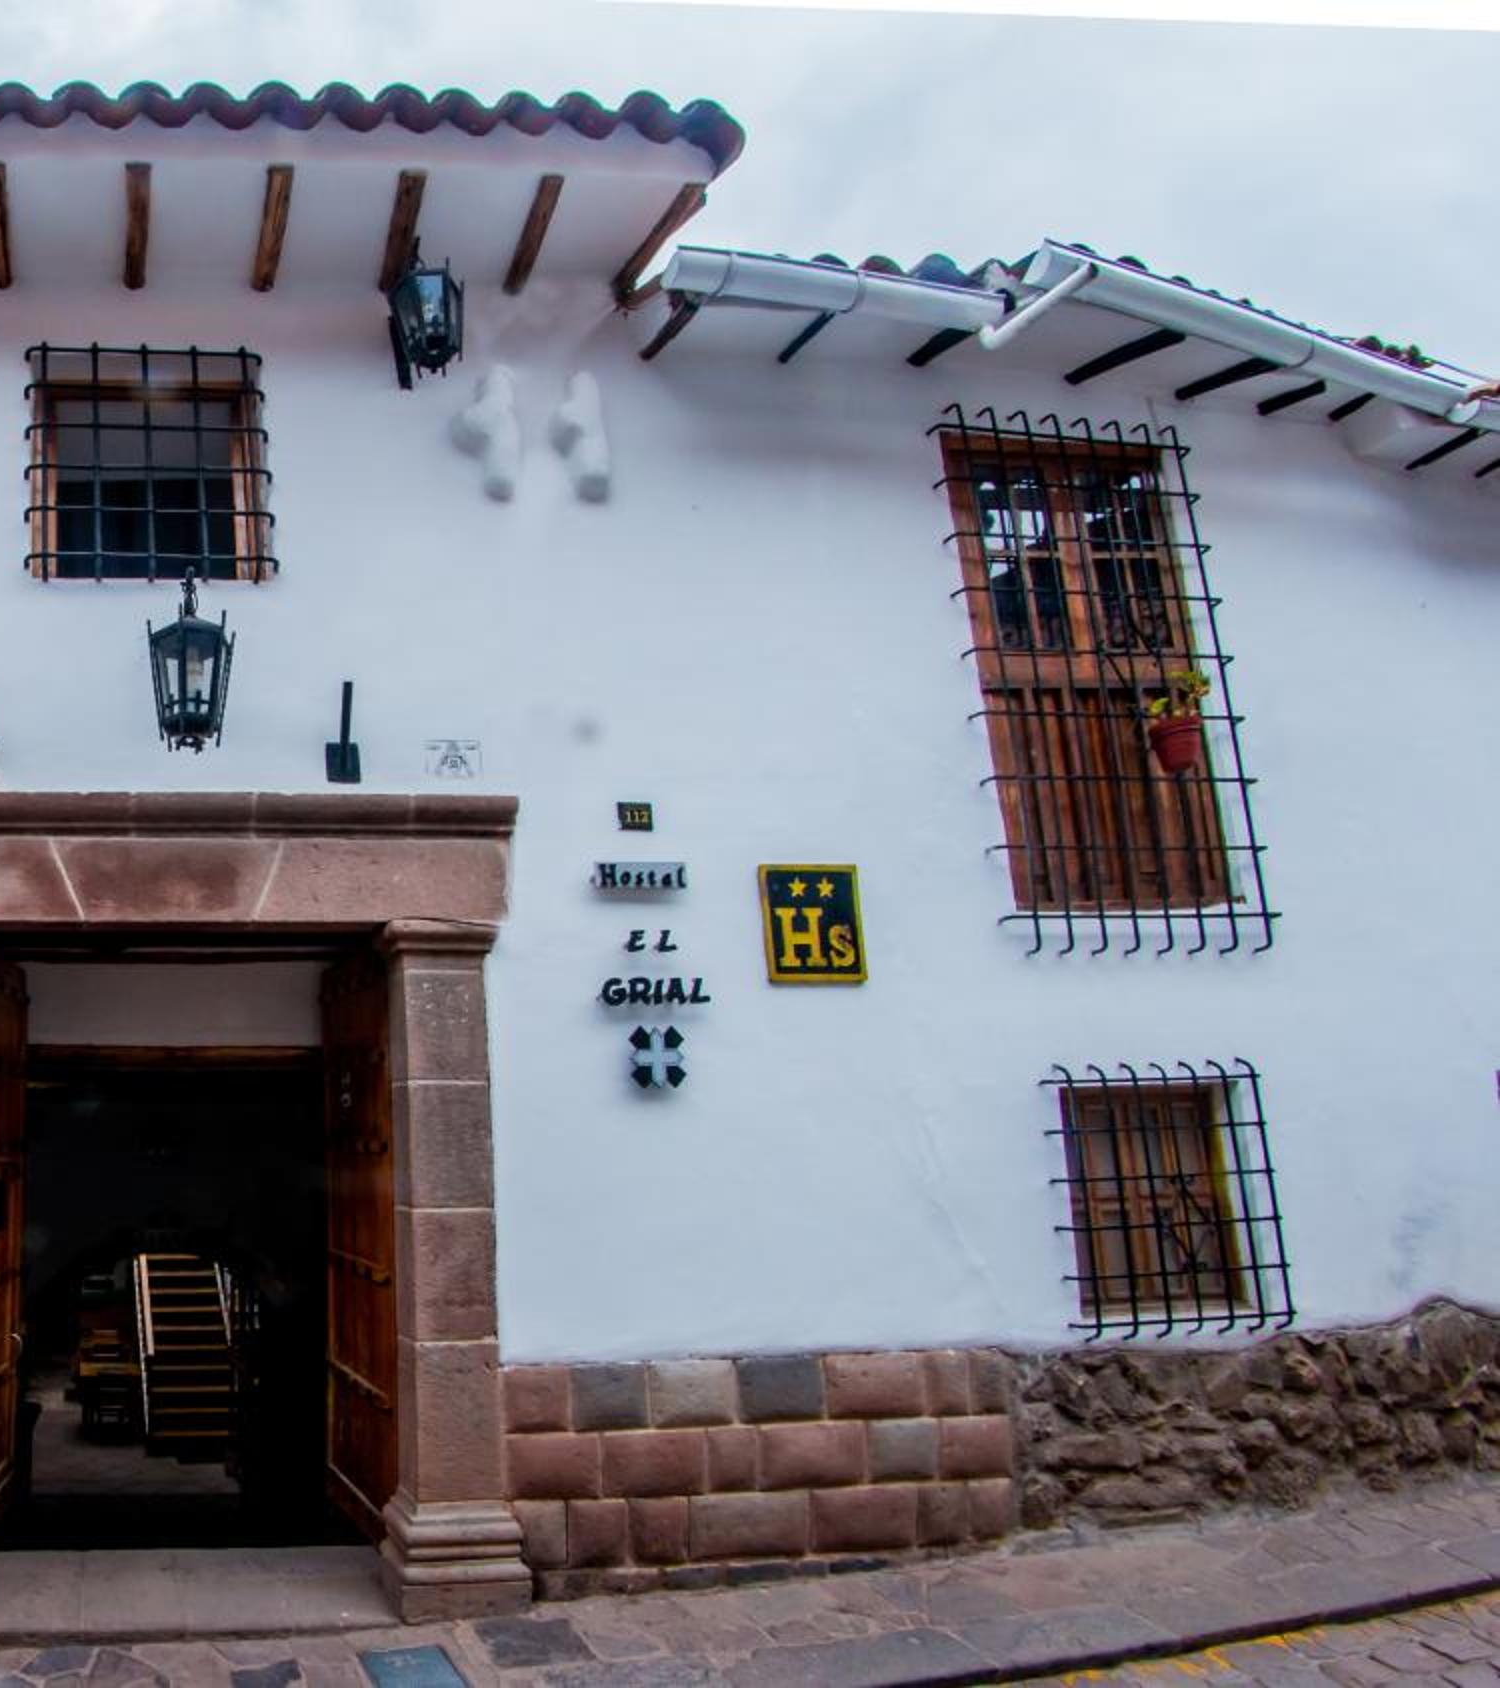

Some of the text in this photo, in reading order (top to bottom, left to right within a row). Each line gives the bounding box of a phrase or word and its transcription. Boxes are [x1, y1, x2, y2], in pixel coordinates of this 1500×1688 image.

[599, 863, 687, 888] Hostal
[626, 929, 677, 952] EL
[601, 977, 711, 1006] GRIAL
